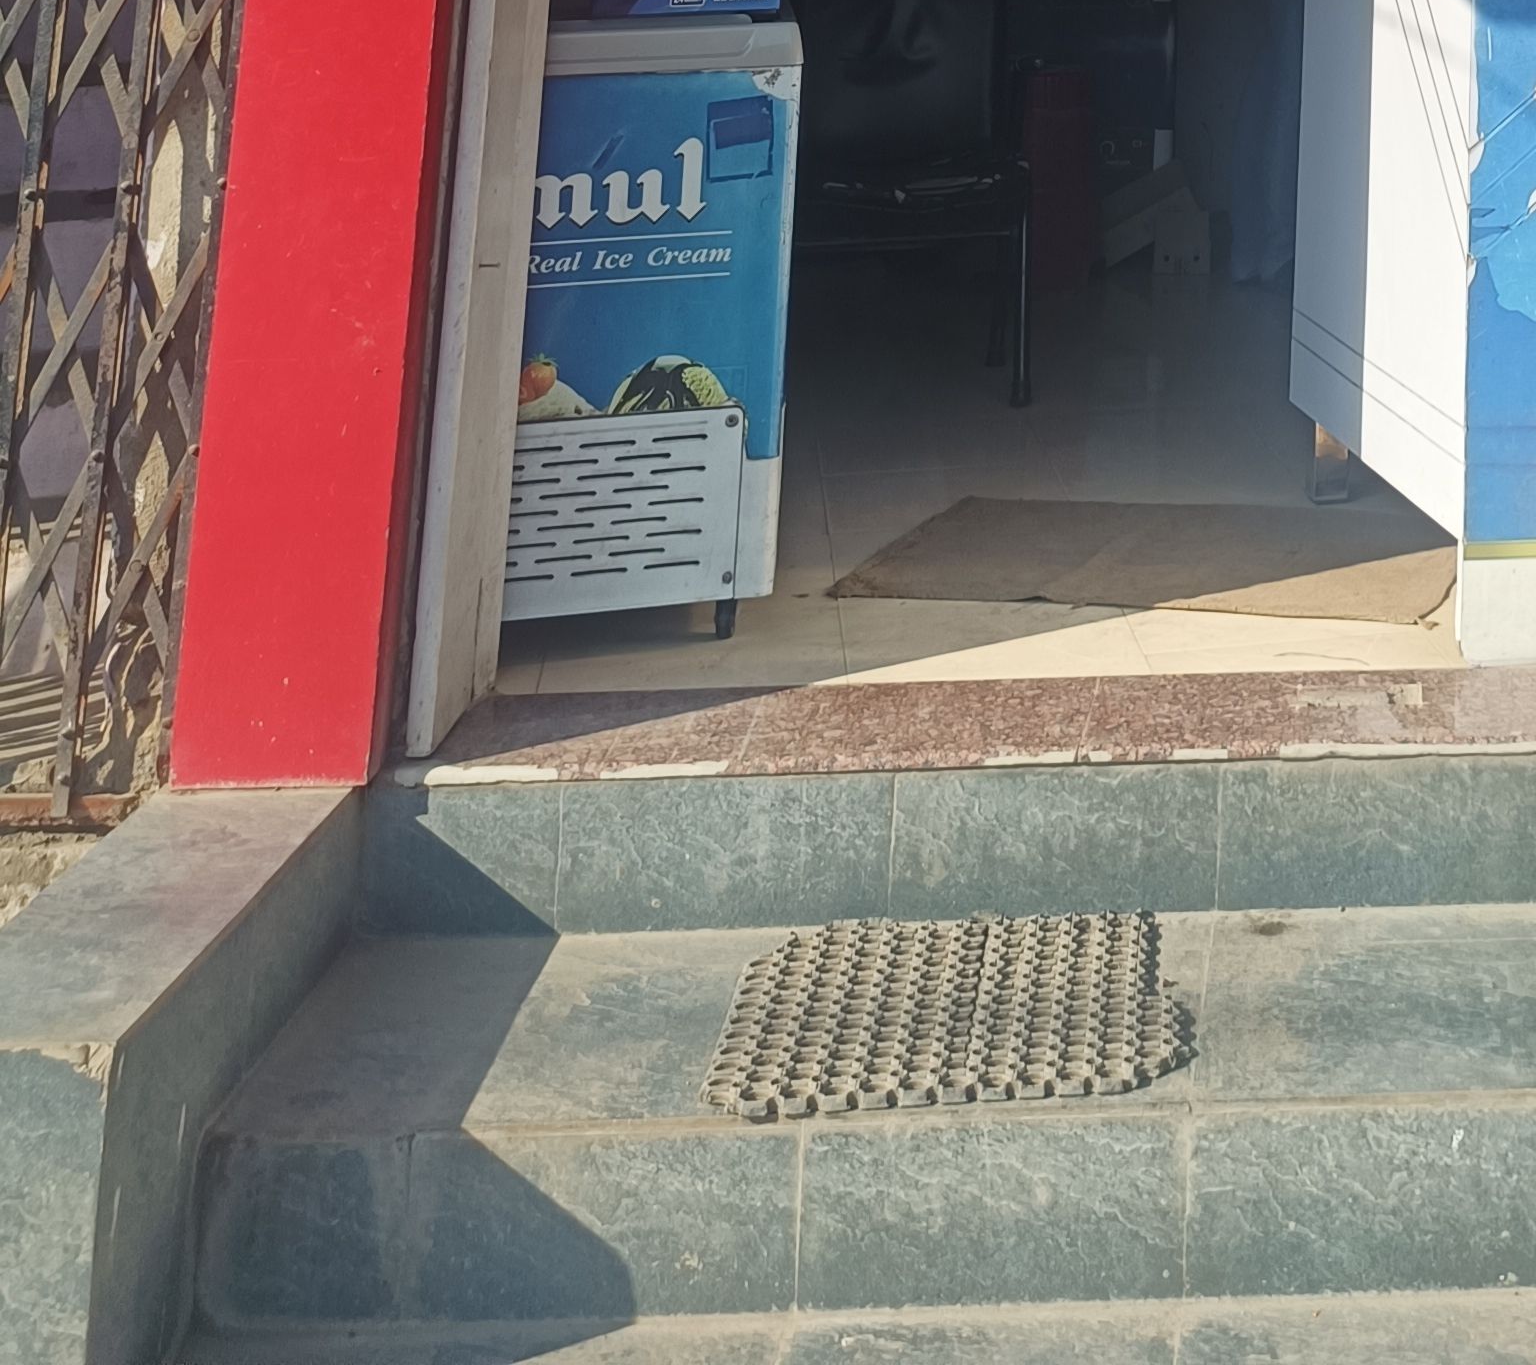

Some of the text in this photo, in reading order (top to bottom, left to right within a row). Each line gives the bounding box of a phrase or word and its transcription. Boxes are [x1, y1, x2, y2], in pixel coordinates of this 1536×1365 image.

[534, 137, 708, 230] mul
[527, 246, 733, 275] Real Ice Cream
